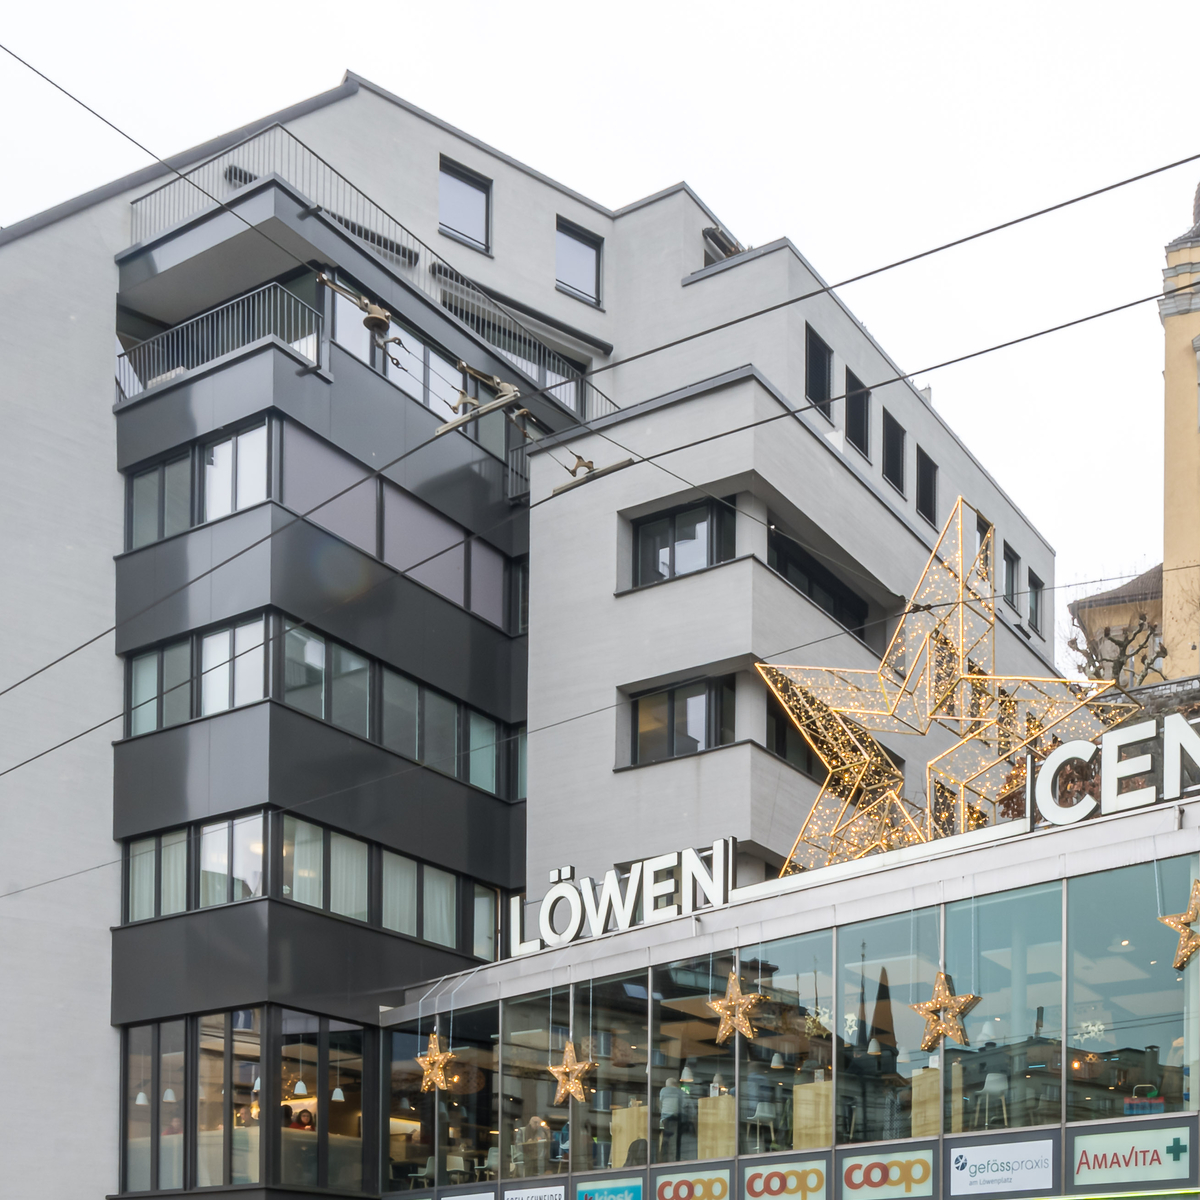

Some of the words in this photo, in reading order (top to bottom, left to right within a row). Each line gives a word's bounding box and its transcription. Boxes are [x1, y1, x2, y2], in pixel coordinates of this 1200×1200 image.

[510, 838, 728, 957] LÖWEN
[844, 1158, 931, 1193] coop
[968, 1155, 1050, 1178] gefässpraxis
[979, 1177, 1013, 1186] Löwenplatz
[746, 1168, 824, 1200] coop
